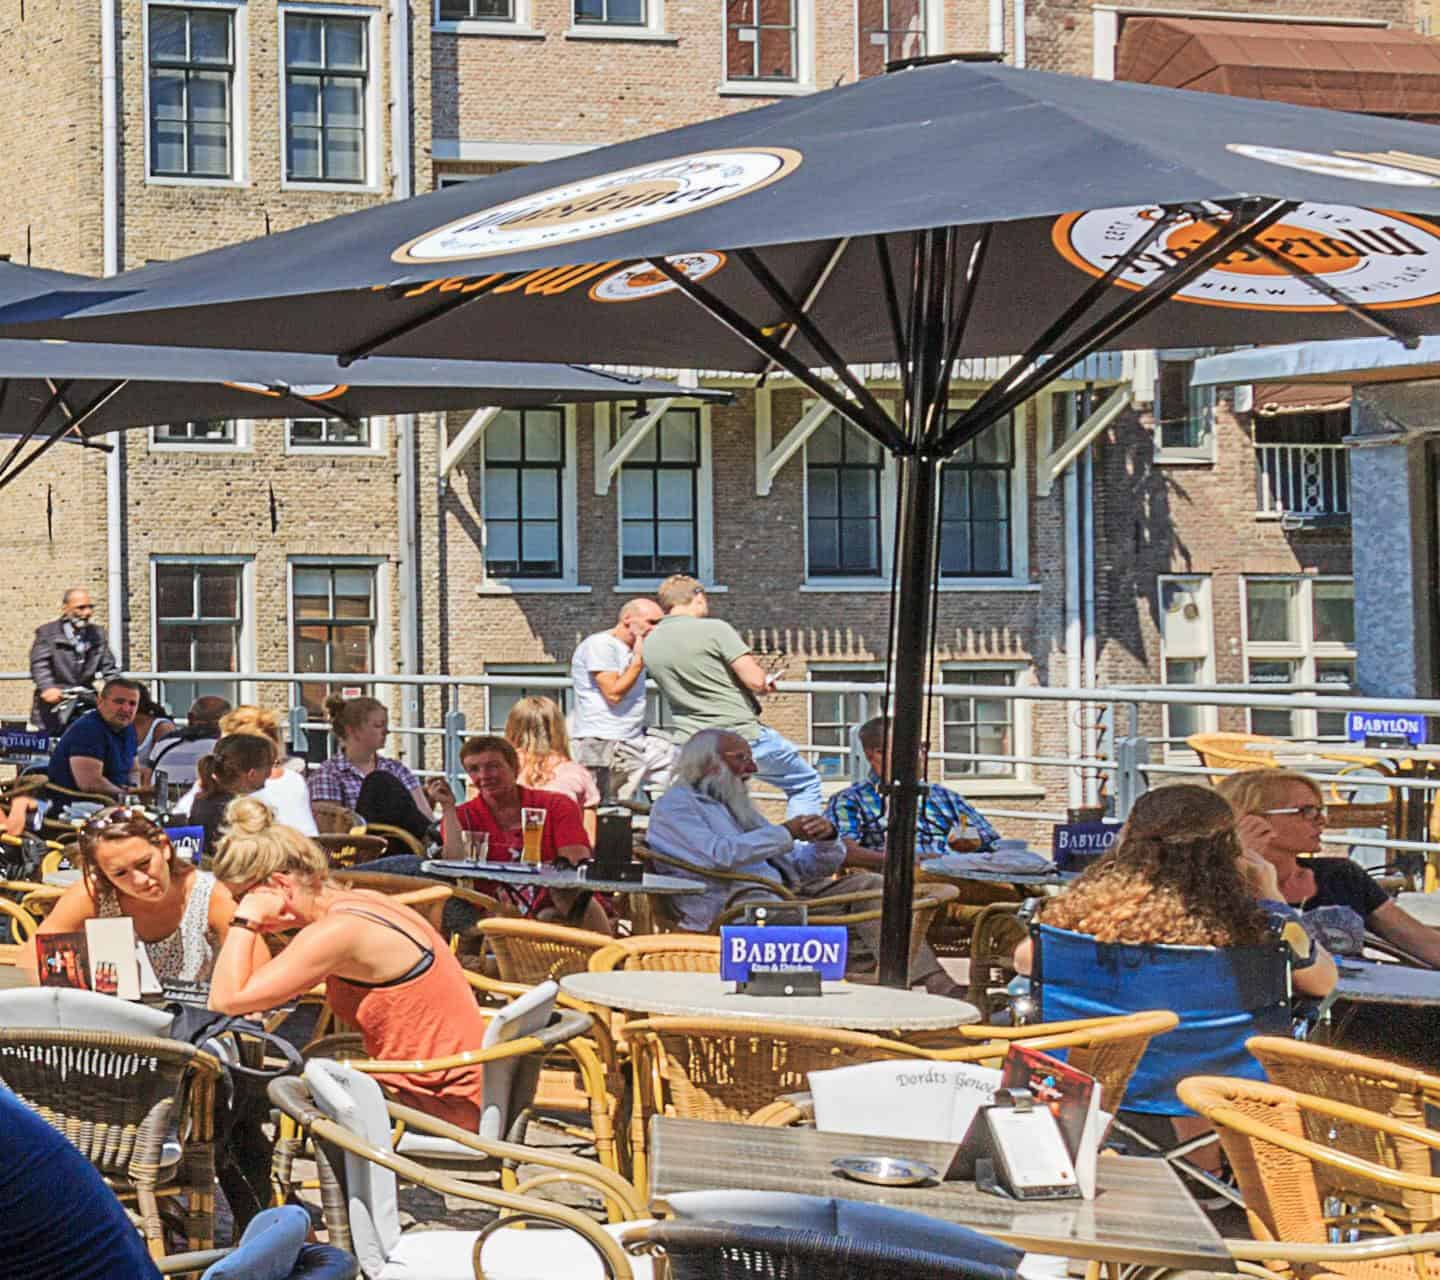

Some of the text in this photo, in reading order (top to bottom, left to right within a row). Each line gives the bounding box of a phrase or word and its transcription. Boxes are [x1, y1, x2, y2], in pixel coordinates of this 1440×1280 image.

[1352, 715, 1419, 733] BABYLON
[1059, 831, 1115, 849] BABYLO
[731, 937, 840, 964] BABYLON
